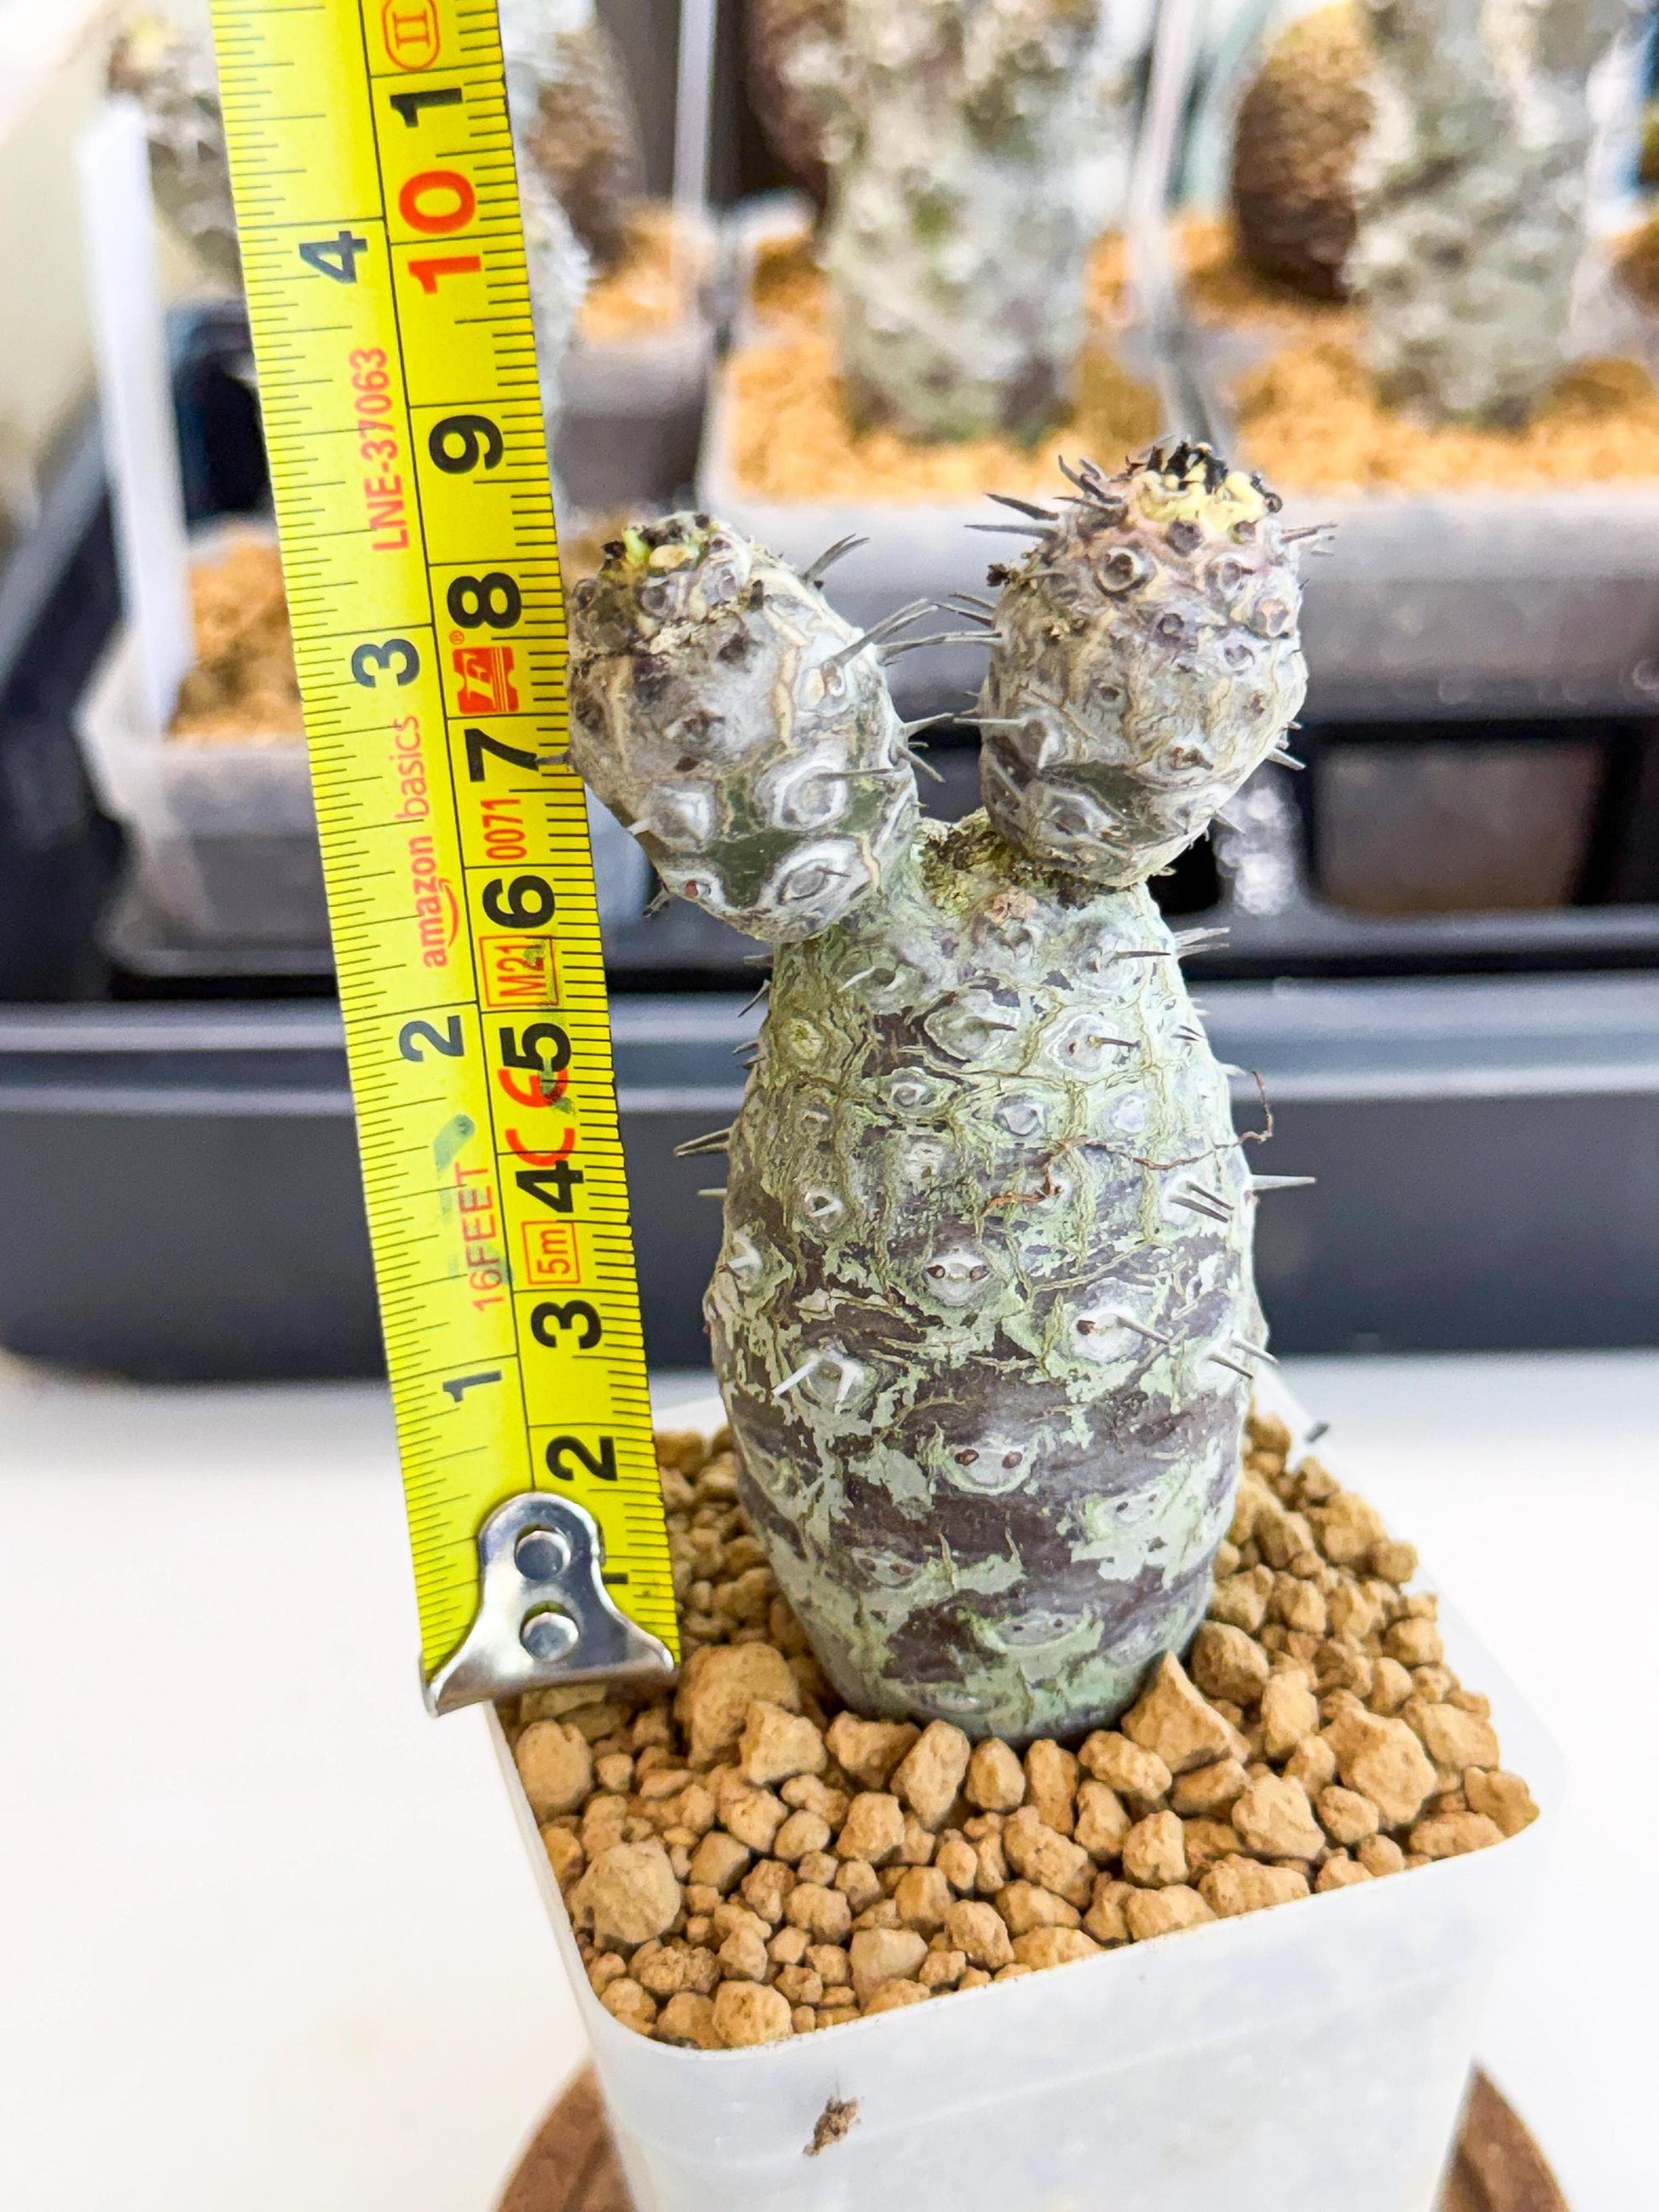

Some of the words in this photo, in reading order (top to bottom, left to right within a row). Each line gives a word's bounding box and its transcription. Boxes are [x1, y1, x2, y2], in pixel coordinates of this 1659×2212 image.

[299, 231, 367, 283] 4
[399, 170, 481, 294] 10
[350, 347, 409, 551] LNE-37063
[429, 414, 504, 475] 9
[447, 572, 522, 629] 8
[351, 638, 420, 689] 3
[389, 714, 430, 823] basics
[465, 729, 540, 783] 7
[481, 798, 528, 860] 0071
[410, 835, 448, 968] amazon
[483, 875, 556, 928] 6
[494, 943, 547, 997] M21
[399, 1014, 465, 1062] 2
[500, 1022, 572, 1072] 5
[516, 1159, 584, 1214] 4
[537, 1229, 572, 1276] 5m
[530, 1299, 603, 1350] 3
[442, 1370, 502, 1402] 1
[546, 1435, 618, 1482] 2
